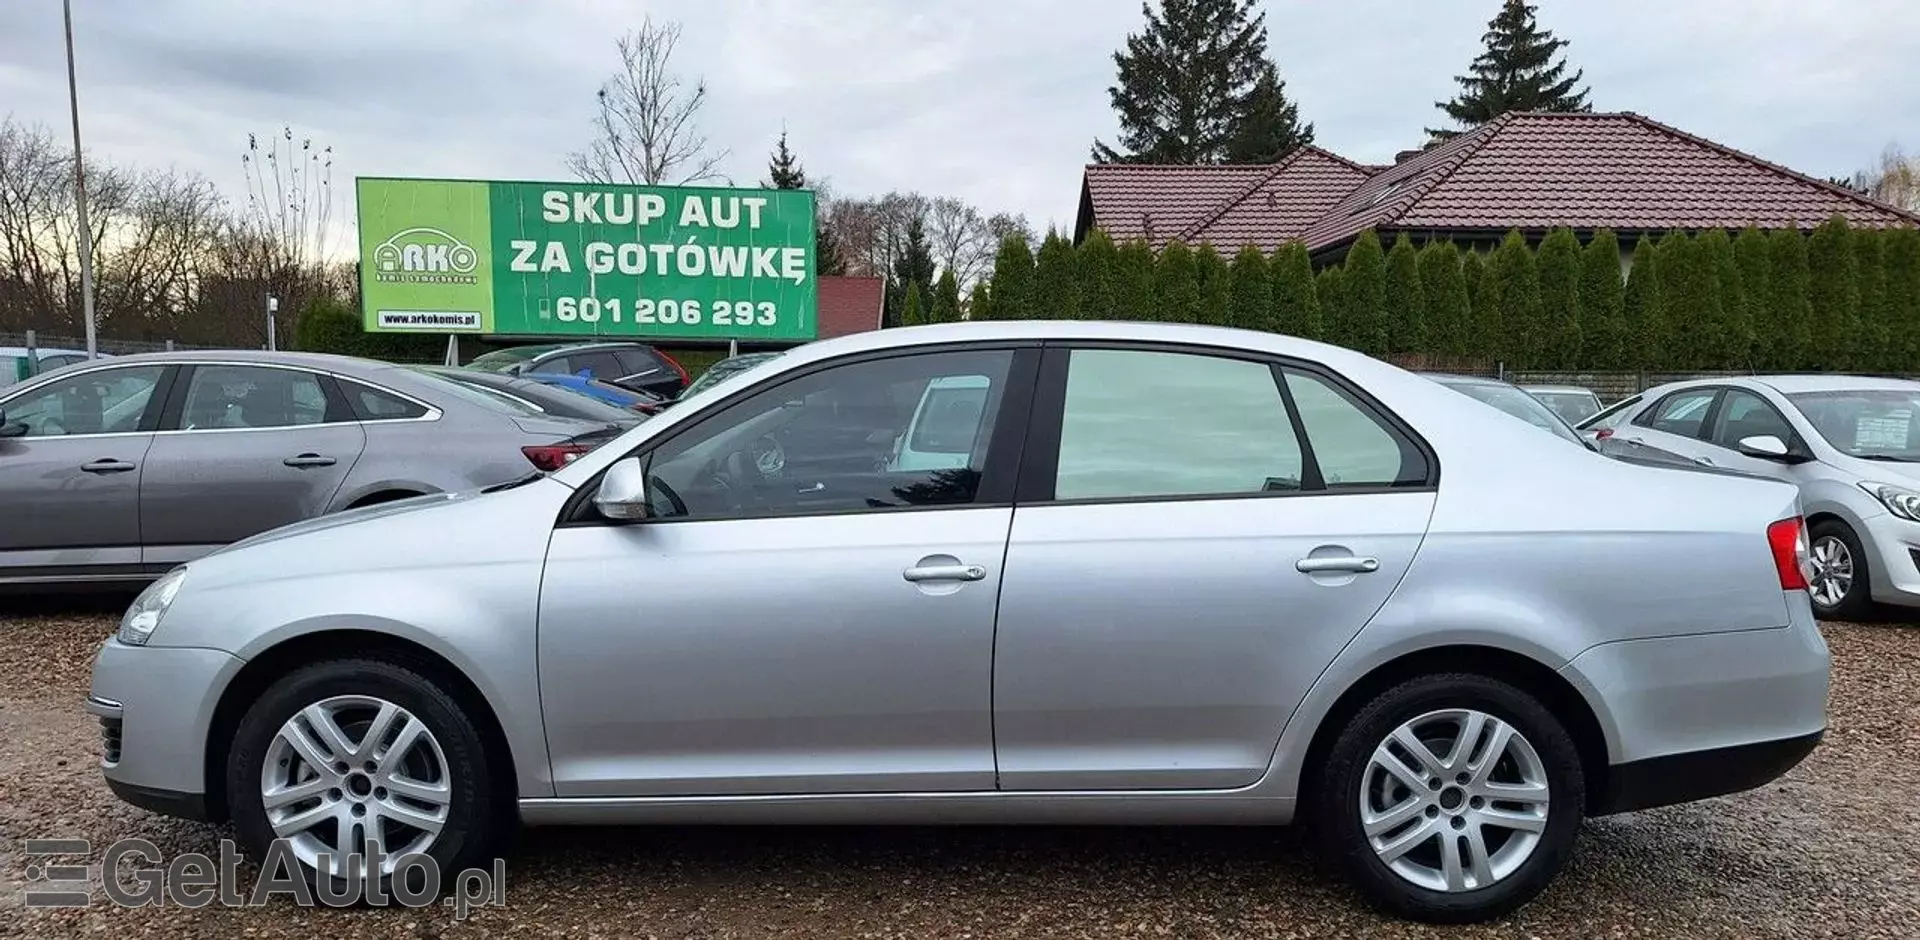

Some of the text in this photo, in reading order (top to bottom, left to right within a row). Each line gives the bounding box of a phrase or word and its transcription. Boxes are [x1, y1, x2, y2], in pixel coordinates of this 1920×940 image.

[542, 190, 767, 229] SKUP AUT
[374, 241, 477, 273] ARKO
[510, 235, 806, 286] ZA GOTÓWKĘ
[383, 314, 475, 326] www.arkokomis.pl
[556, 296, 777, 326] 601 206 293
